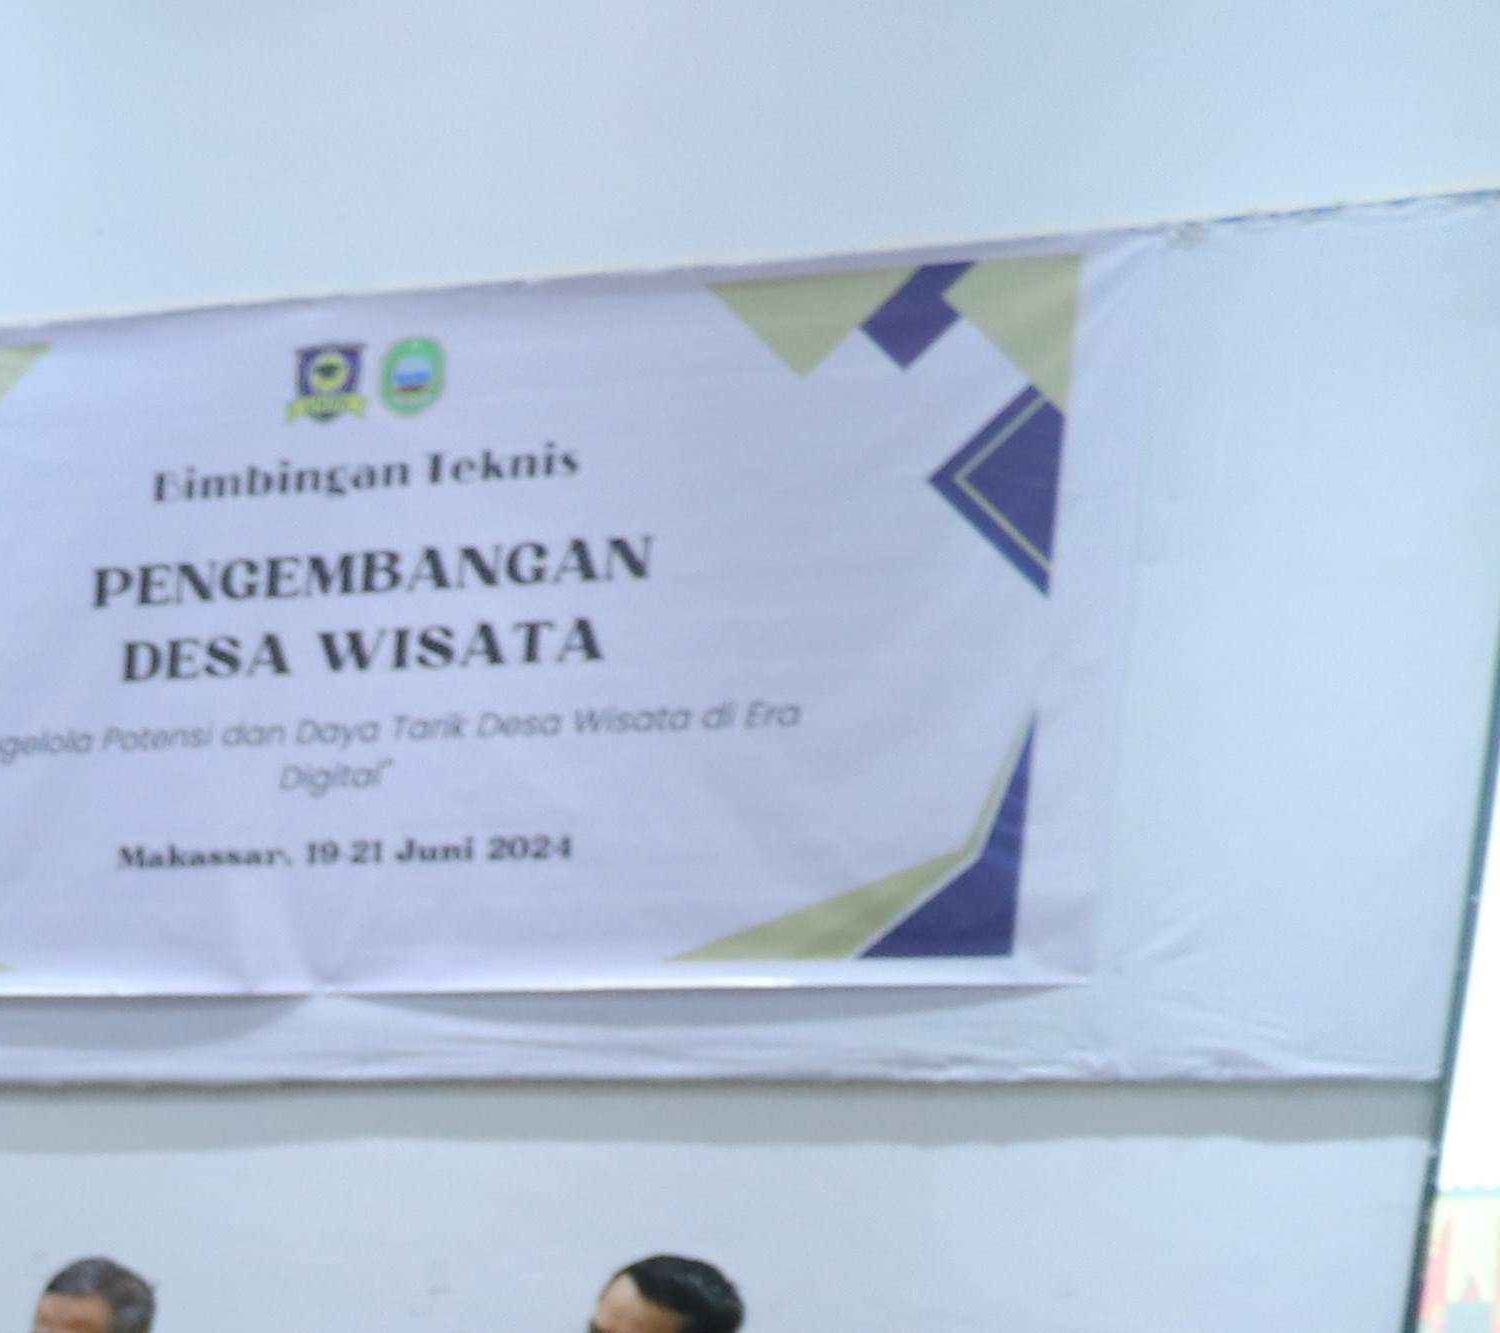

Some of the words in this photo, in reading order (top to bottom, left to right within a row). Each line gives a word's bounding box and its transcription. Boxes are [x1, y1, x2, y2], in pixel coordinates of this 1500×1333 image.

[153, 453, 409, 503] Bimbingan
[427, 441, 580, 485] Teknis
[92, 534, 654, 610] PENGEMBANGAN
[122, 631, 291, 683] DESA
[317, 616, 605, 674] WISATA
[102, 719, 214, 752] Potensi
[222, 719, 285, 748] dan
[295, 718, 380, 750] Daya
[393, 711, 467, 742] Tarik
[477, 711, 563, 740] Desa
[574, 703, 692, 735] Wisata
[700, 699, 736, 731] di
[744, 699, 803, 730] Era
[396, 836, 474, 863] Juni
[486, 833, 573, 861] 2024
